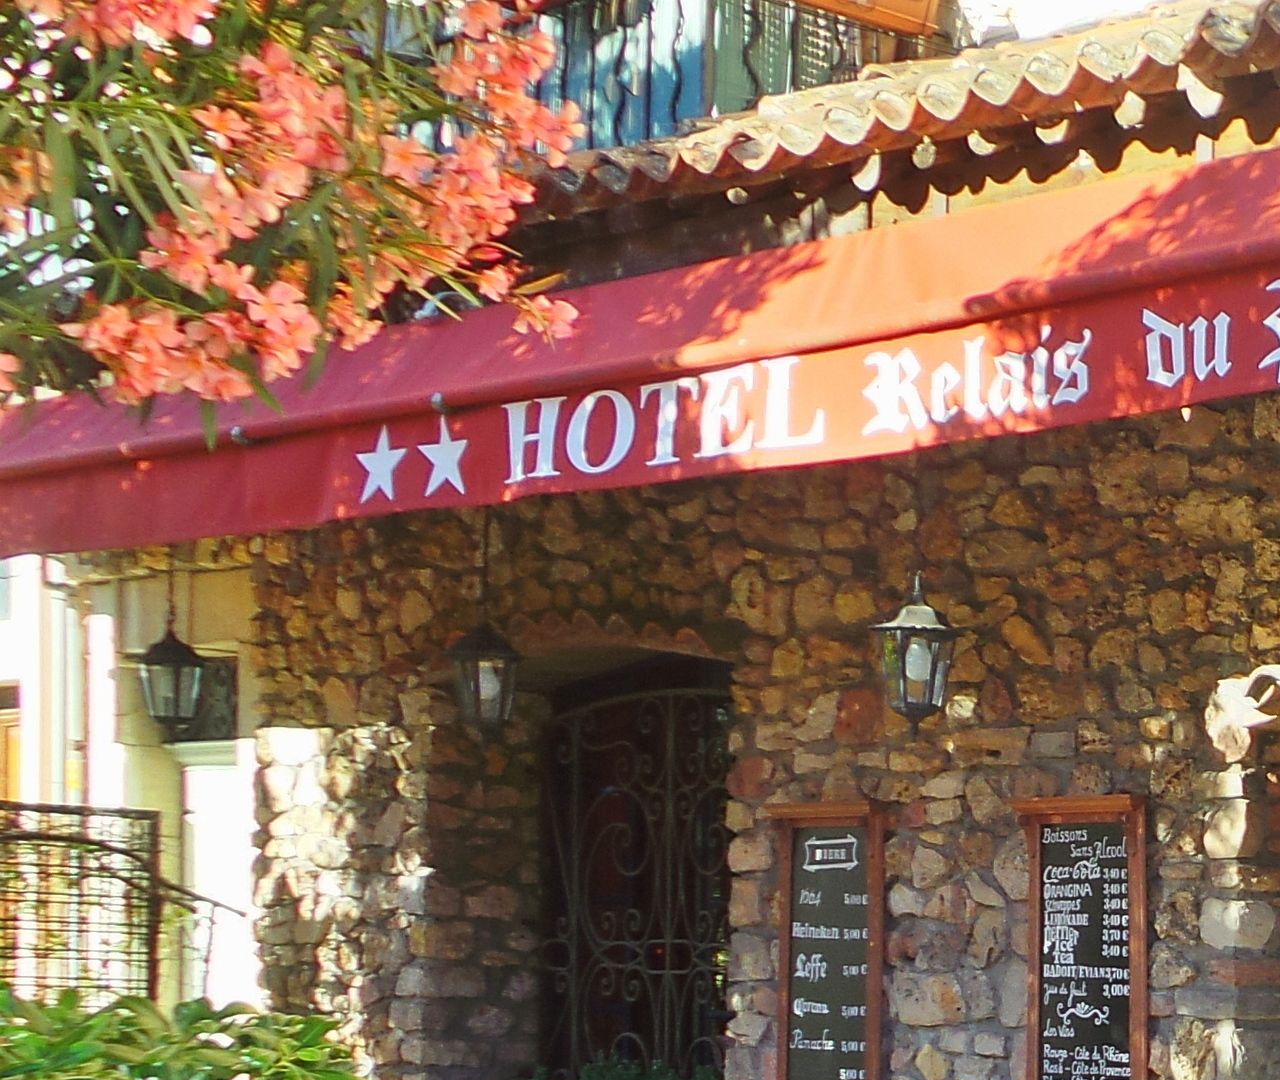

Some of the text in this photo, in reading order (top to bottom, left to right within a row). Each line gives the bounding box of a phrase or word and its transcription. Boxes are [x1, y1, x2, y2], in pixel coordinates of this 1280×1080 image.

[503, 357, 825, 485] HOTEL
[861, 326, 1093, 437] Relais
[1143, 309, 1232, 387] du
[1042, 828, 1087, 843] Boissons
[794, 953, 827, 983] Leffe
